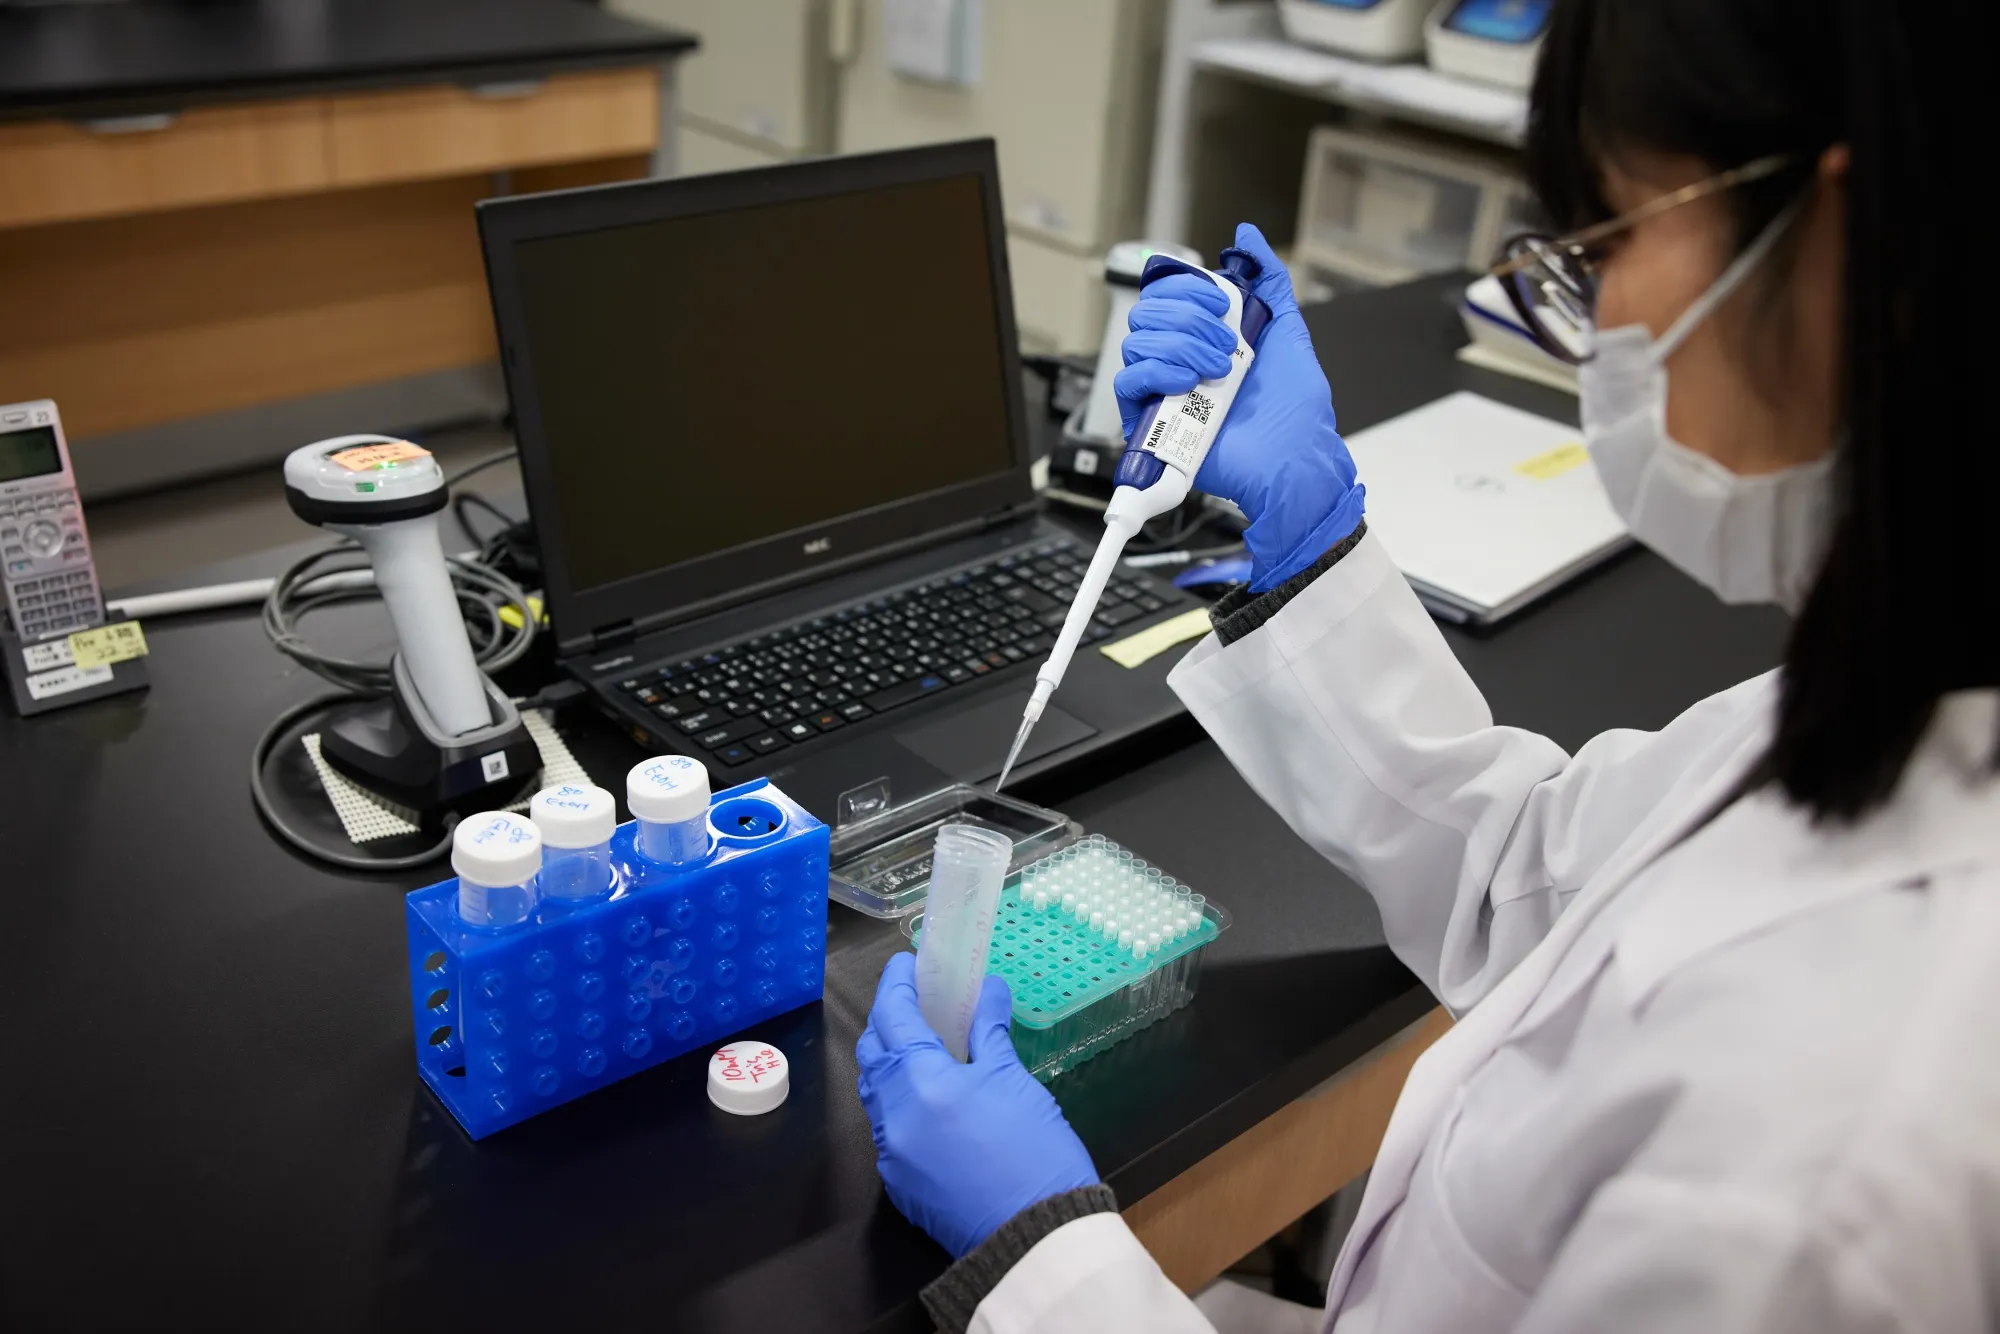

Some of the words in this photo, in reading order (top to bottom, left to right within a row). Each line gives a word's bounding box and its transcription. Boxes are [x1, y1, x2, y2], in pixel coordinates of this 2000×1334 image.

[1147, 420, 1167, 448] RAININ
[670, 757, 693, 769] 80
[558, 786, 583, 796] 80
[644, 764, 679, 791] EtOH
[746, 1055, 768, 1084] Tris
